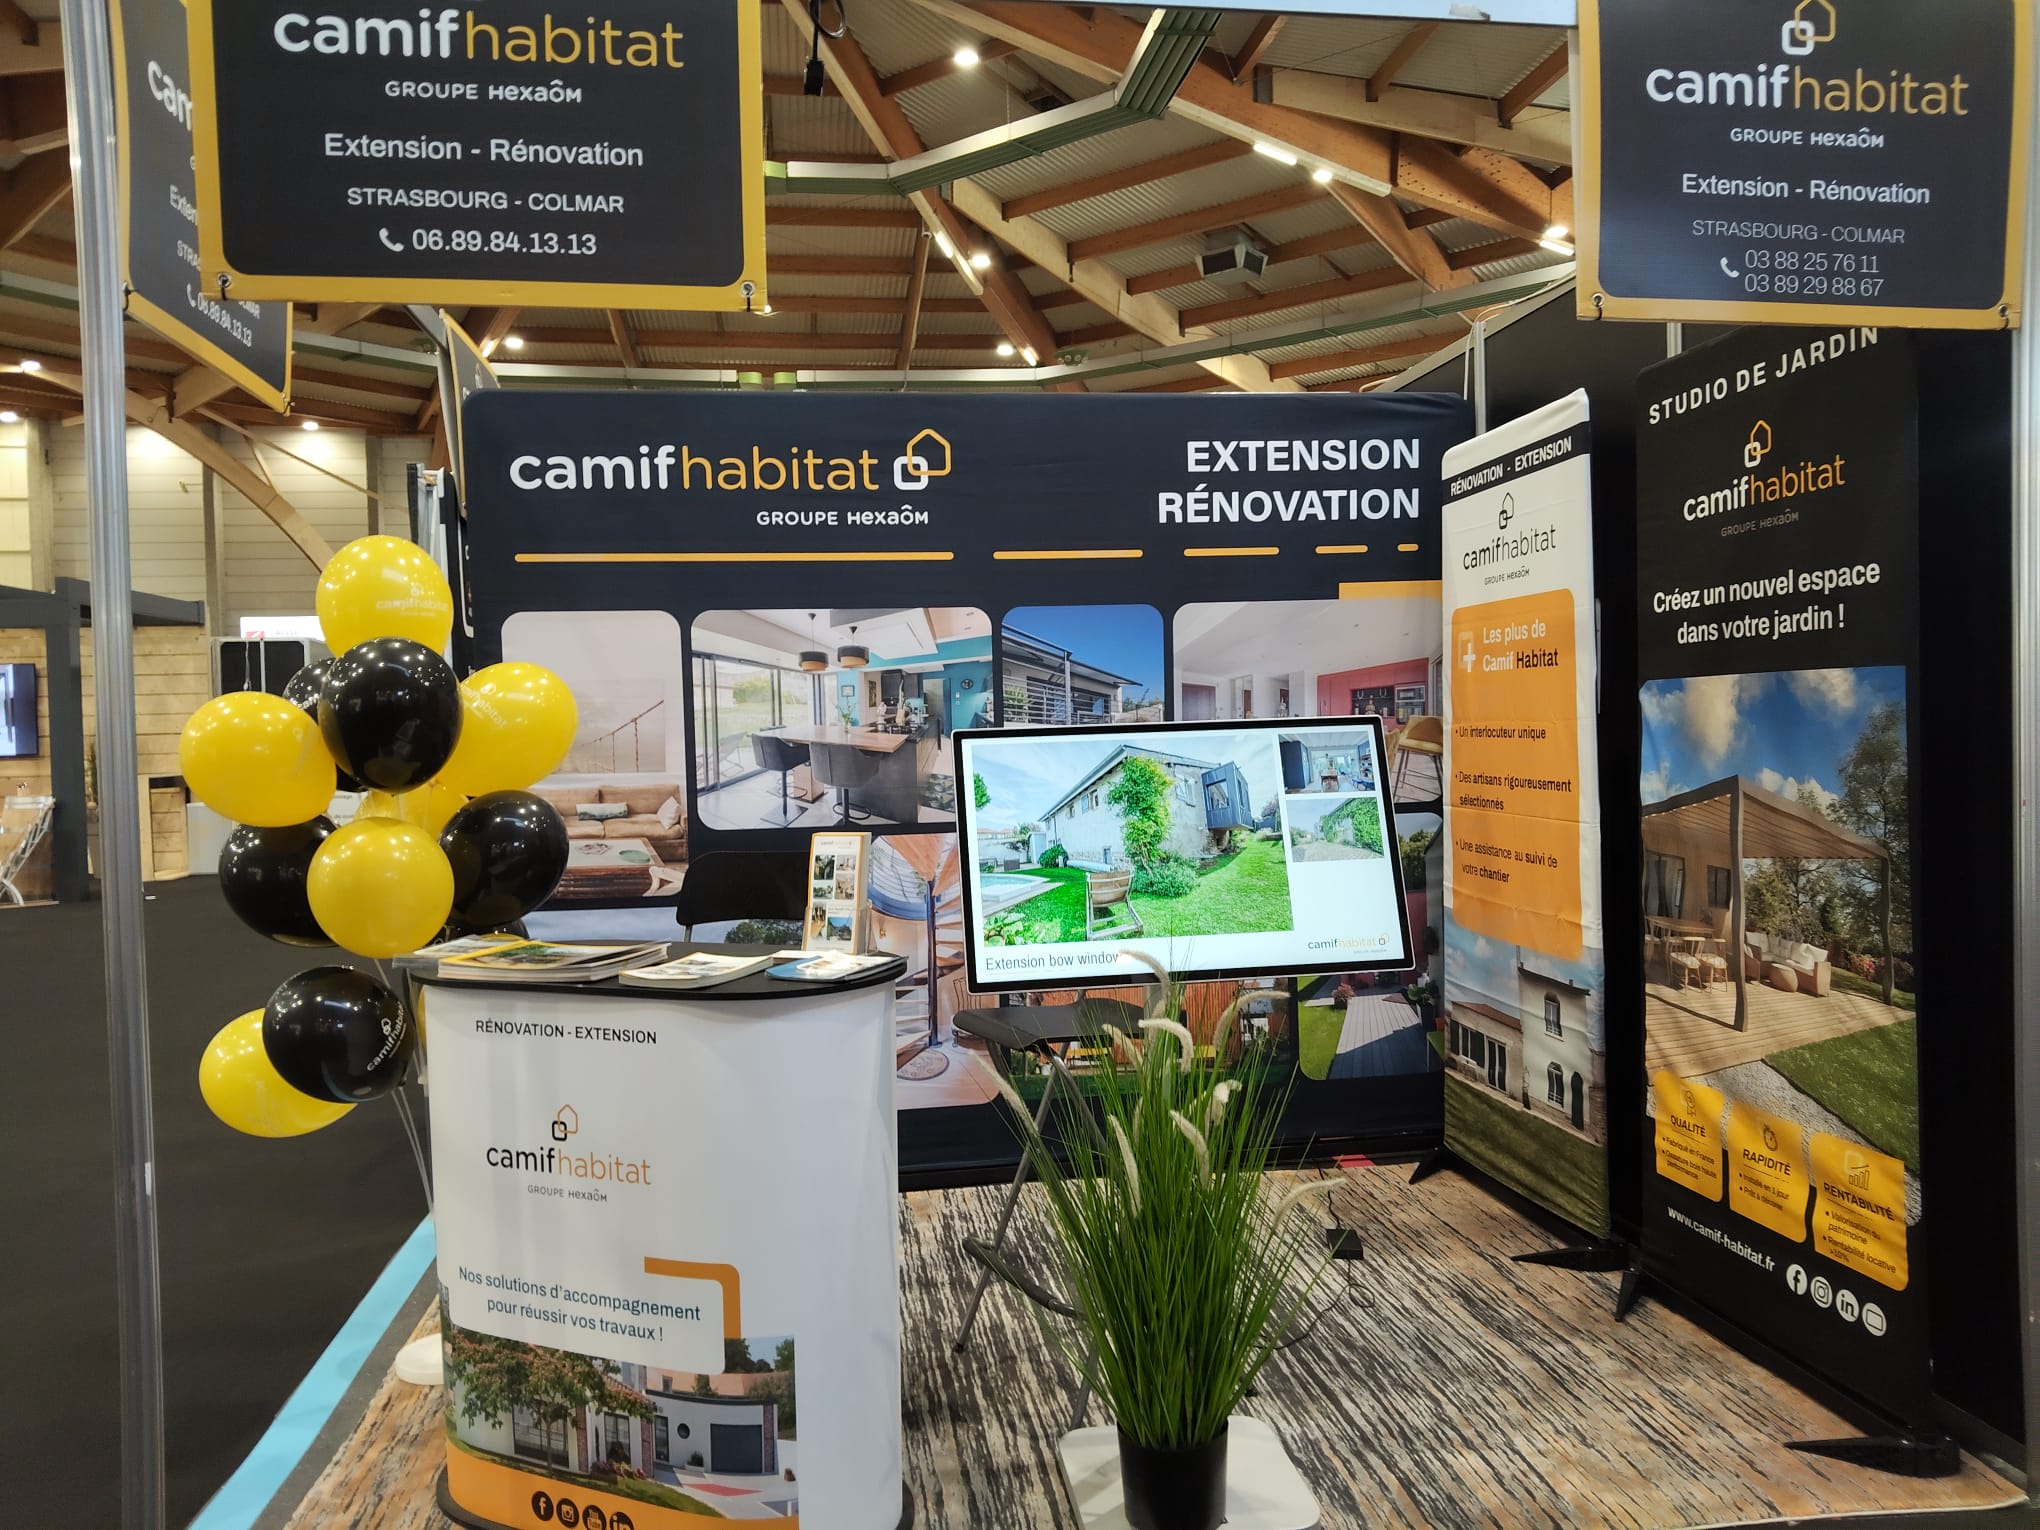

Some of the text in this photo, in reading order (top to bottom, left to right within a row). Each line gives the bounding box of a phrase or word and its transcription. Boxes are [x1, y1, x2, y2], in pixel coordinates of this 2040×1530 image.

[385, 80, 478, 99] GROUPE
[1730, 127, 1803, 145] GROUPE
[325, 133, 461, 161] Extension
[490, 137, 643, 166] Rénovation
[347, 187, 507, 210] STRASBOURG
[528, 192, 624, 213] COLMAR
[1682, 173, 1788, 198] Extension
[1810, 179, 1930, 204] Rénovation
[412, 228, 596, 255] 06.89.84.13.13
[1692, 220, 1818, 241] STRASBOURG
[1831, 226, 1905, 244] COLMAR
[1745, 250, 1879, 273] 03 88 25 76 11
[1744, 273, 1884, 297] 03 89 29 88 67
[1649, 327, 1878, 425] STUDIO DE JARDIN
[1187, 438, 1419, 472] EXTENSION
[1450, 463, 1503, 496] RÉNOVATION
[1514, 436, 1572, 472] EXTENSION
[1158, 483, 1419, 524] RÉNOVATION
[756, 511, 838, 526] GROUPE
[1721, 520, 1756, 537] GROUPE
[1484, 573, 1505, 586] GROUPE
[1653, 562, 1881, 614] Créez un nouvel espace
[1483, 619, 1546, 645] Les plus de
[1677, 621, 1719, 645] dans
[1722, 615, 1770, 640] votre
[1772, 605, 1833, 640] jardin
[1483, 648, 1559, 672] Camif Habitat
[1459, 725, 1546, 741] Un interlocuteur unique
[1459, 771, 1572, 792] Des artisans rigoureusement
[1460, 794, 1504, 810] sélectionnés
[1459, 838, 1558, 868] Une assistance au suivi de
[1461, 863, 1510, 883] votre chantier
[986, 957, 1045, 971] Extension
[1049, 953, 1074, 967] bow
[476, 1017, 564, 1038] RÉNOVATION
[575, 1026, 657, 1044] EXTENSION
[1670, 1115, 1706, 1138] QUALITÉ
[1743, 1148, 1791, 1176] RAPIDITÉ
[528, 1184, 564, 1197] GROUPE
[1823, 1182, 1895, 1221] RENTABILITÉ
[1667, 1206, 1775, 1272] www.camif-habitat.fr
[459, 1266, 483, 1285] Nos
[486, 1273, 547, 1297] solutions
[487, 1298, 518, 1315] pour
[520, 1304, 568, 1325] réussir
[570, 1315, 597, 1331] vos
[600, 1316, 656, 1341] travaux
